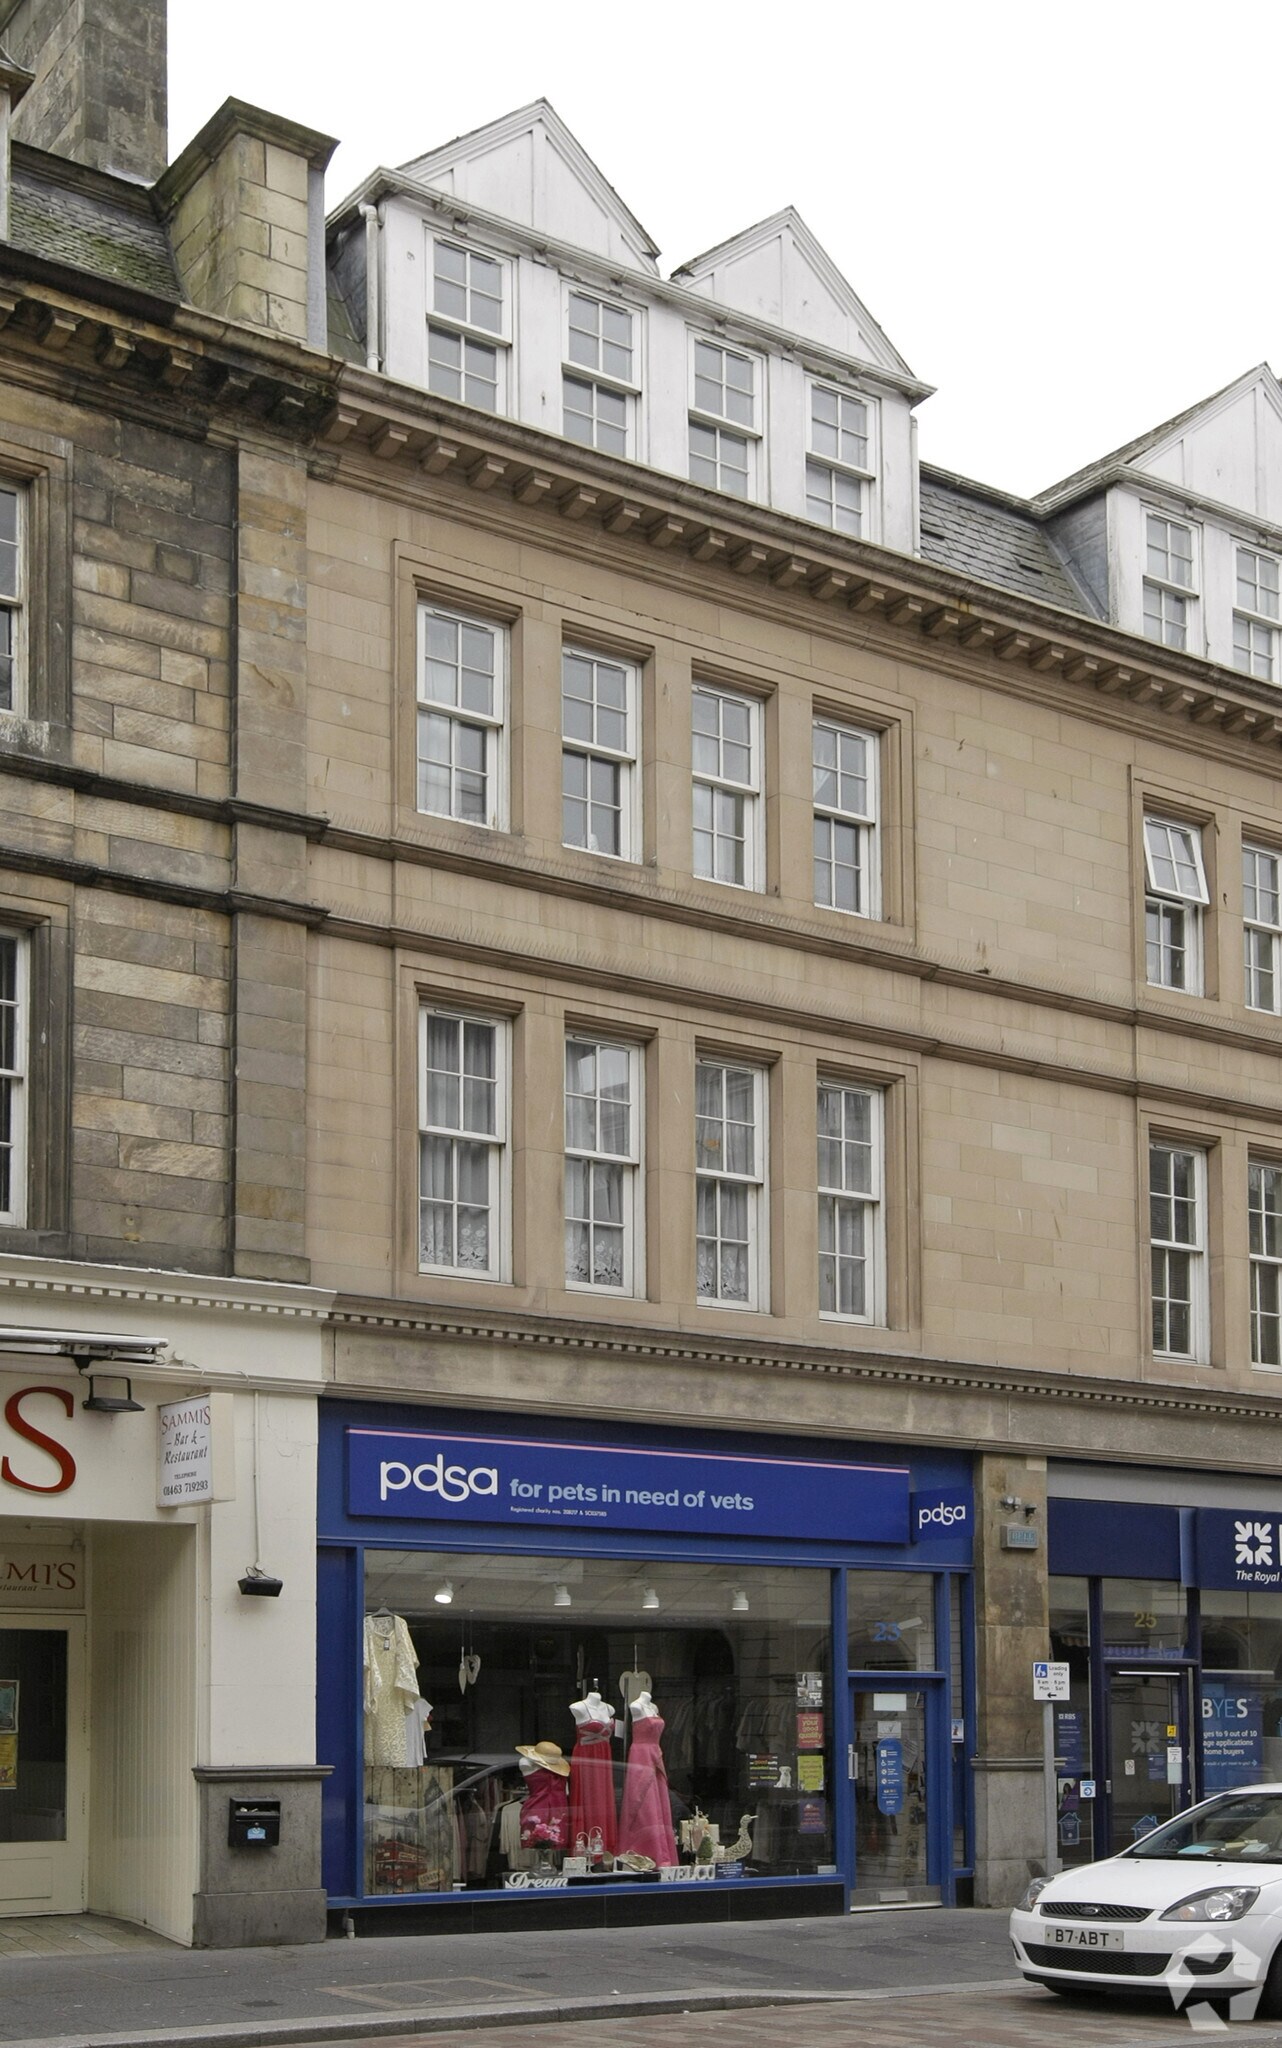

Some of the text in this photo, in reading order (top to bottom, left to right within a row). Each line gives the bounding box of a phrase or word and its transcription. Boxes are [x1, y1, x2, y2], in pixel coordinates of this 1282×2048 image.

[174, 1432, 189, 1446] Bar
[164, 1446, 208, 1465] Restaurant
[380, 1454, 498, 1502] pdsa
[163, 1481, 208, 1496] 01463 719293
[509, 1479, 755, 1510] for pets in need of vets
[535, 1507, 551, 1515] charity
[919, 1502, 966, 1529] pdsa
[0, 1562, 76, 1590] MI'S
[1236, 1570, 1280, 1585] The Royal
[1134, 1611, 1157, 1628] 25
[874, 1622, 899, 1641] 23
[1203, 1731, 1214, 1739] yes
[1216, 1739, 1254, 1747] applications
[1223, 1748, 1244, 1756] buyers
[505, 1872, 568, 1889] Dream
[659, 1865, 716, 1882] WELCO
[1078, 1931, 1109, 1946] ABT
